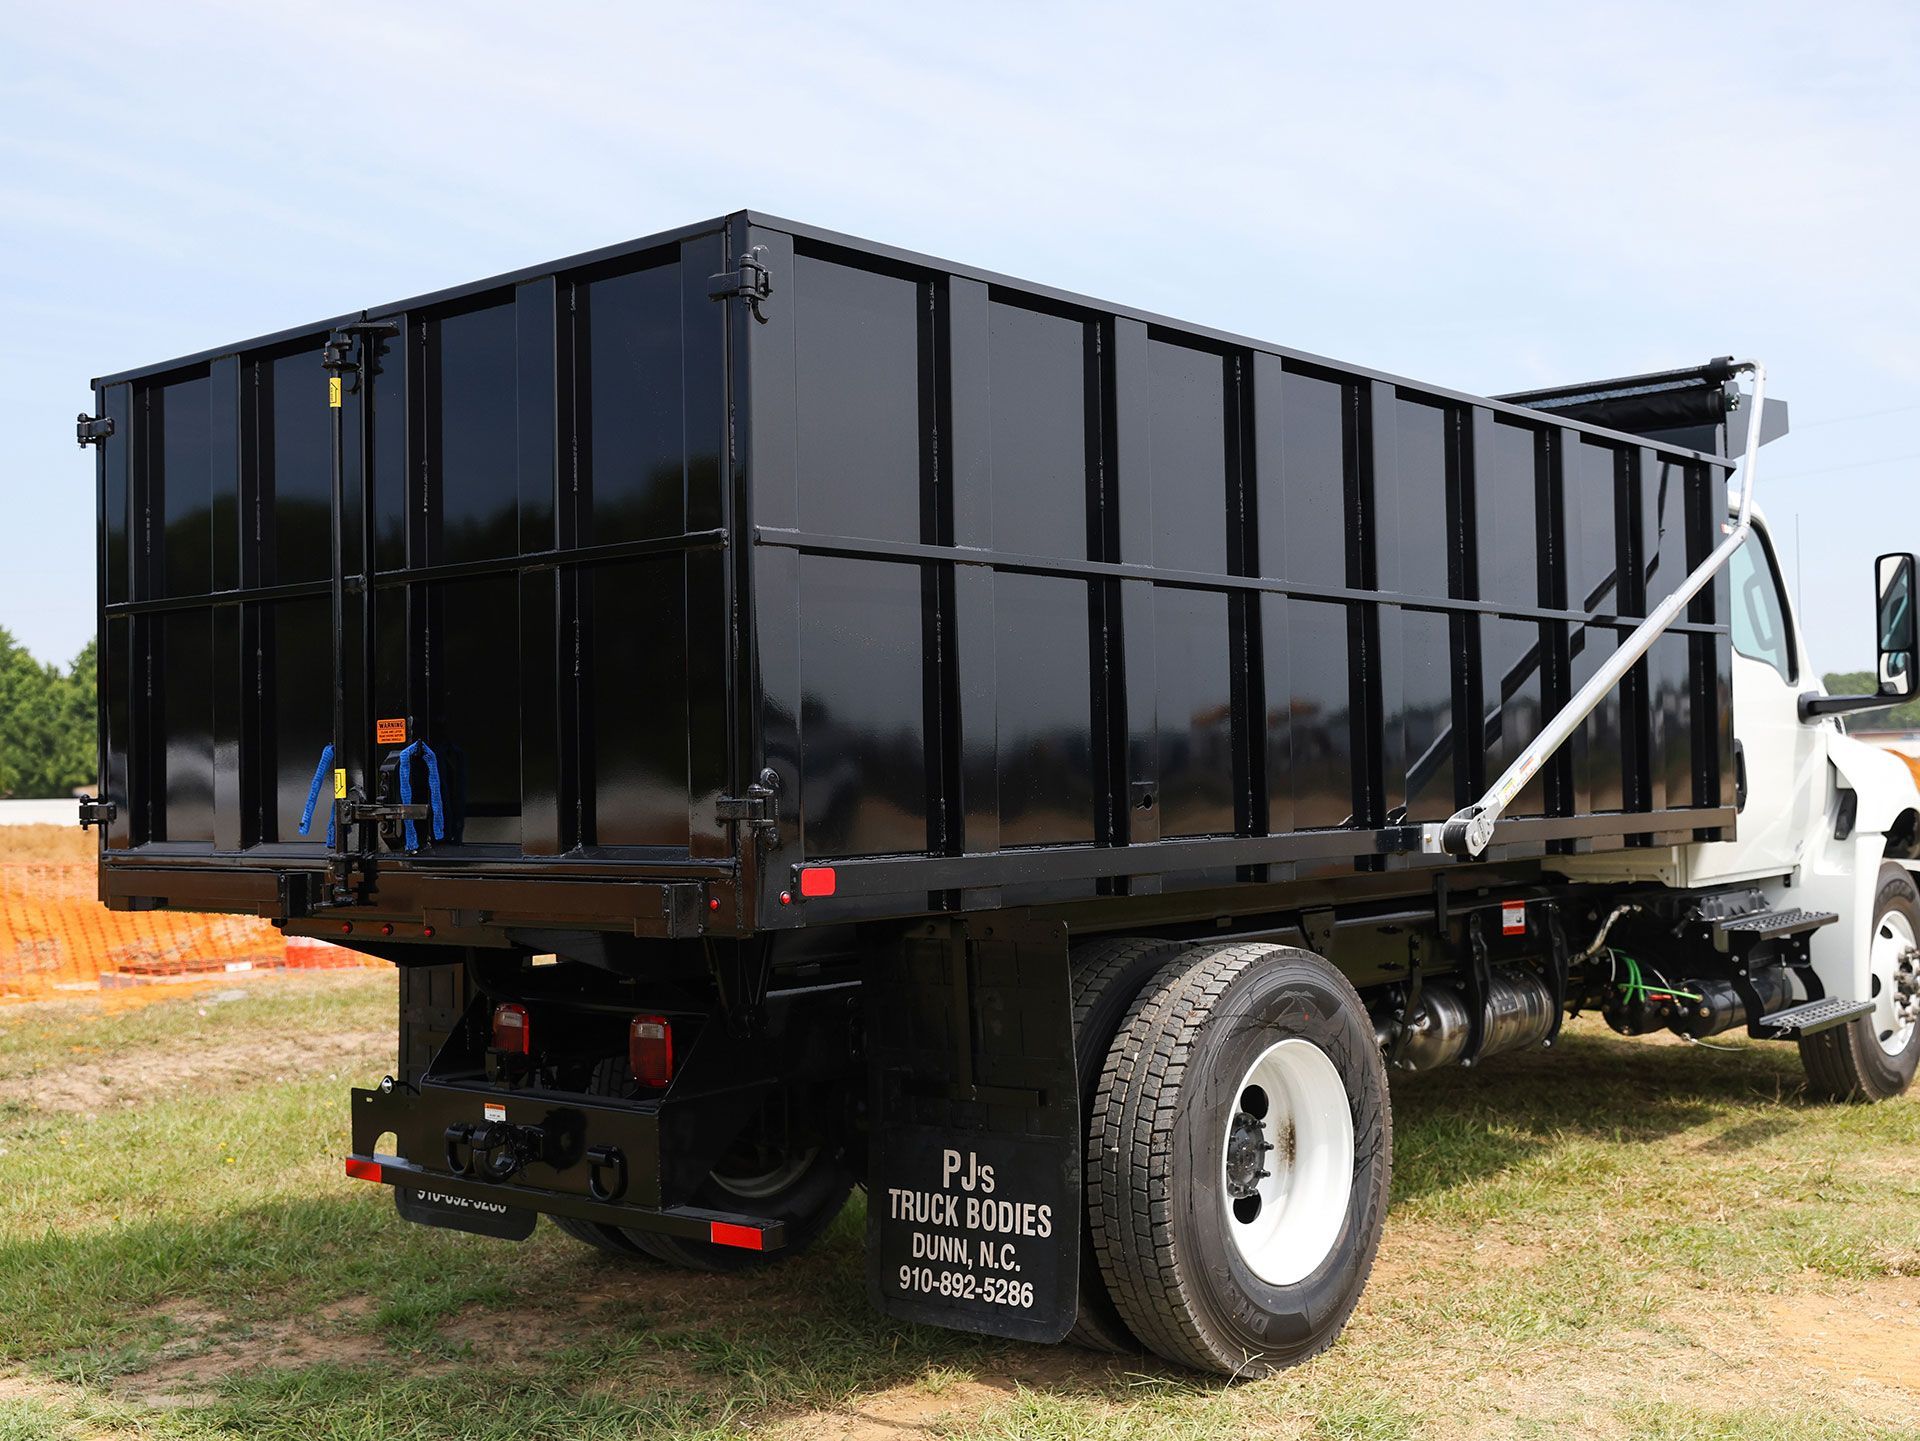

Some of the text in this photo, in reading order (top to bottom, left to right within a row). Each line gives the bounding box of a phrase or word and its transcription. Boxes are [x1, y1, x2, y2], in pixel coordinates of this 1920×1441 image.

[888, 1188, 1052, 1238] TRUCK BODIES
[912, 1232, 1021, 1272] DUNN, N.C.
[899, 1265, 1034, 1308] 910-892-5286
